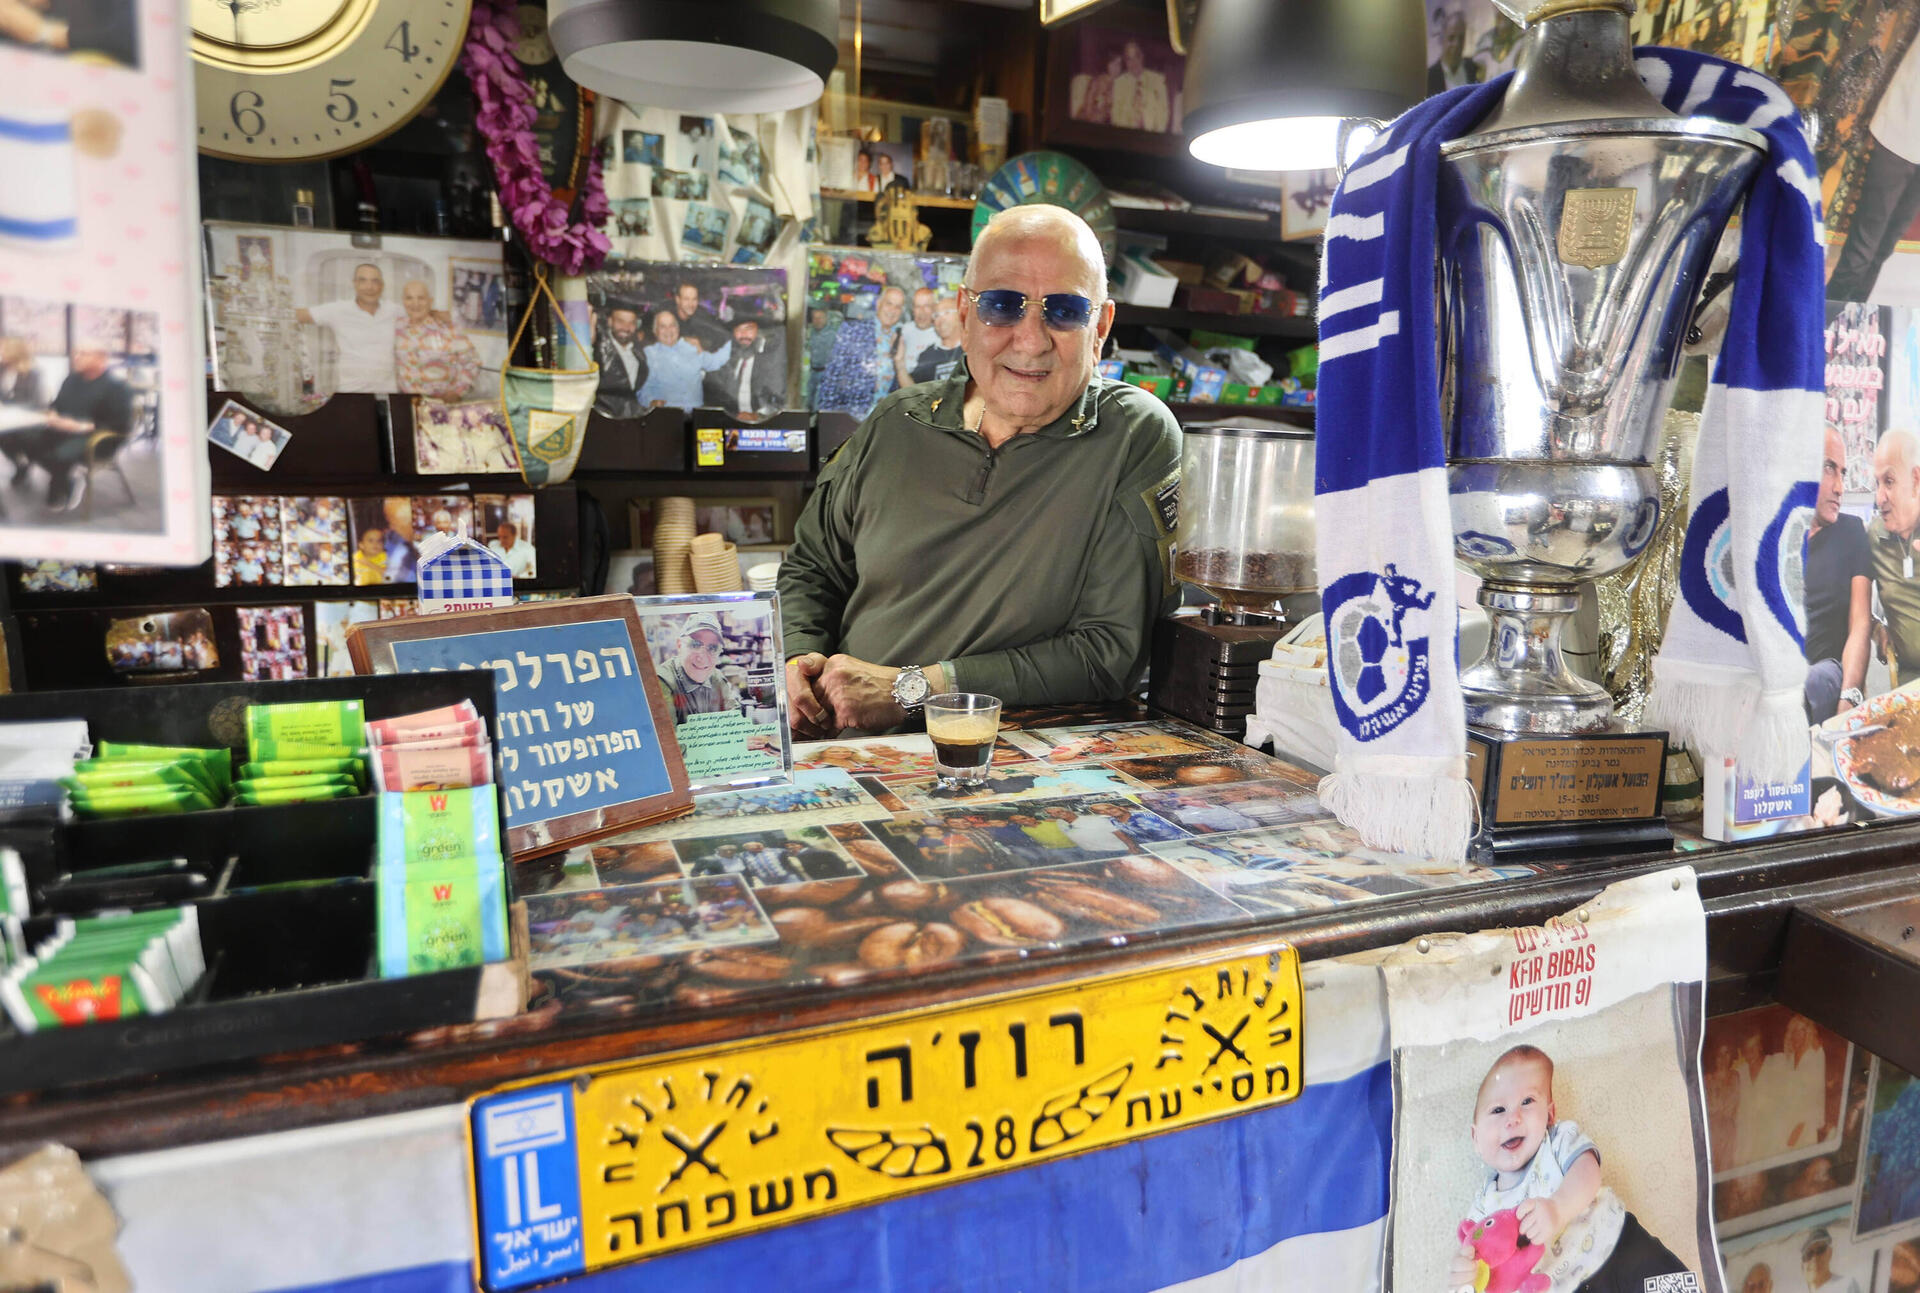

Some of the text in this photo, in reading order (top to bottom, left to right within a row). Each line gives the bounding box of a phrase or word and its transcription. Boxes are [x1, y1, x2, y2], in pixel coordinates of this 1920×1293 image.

[385, 20, 420, 63] 4
[230, 90, 266, 136] 6
[325, 78, 358, 122] 5
[412, 646, 633, 692] הפרלמ
[555, 700, 594, 729] של
[528, 728, 641, 766] הפרופסור
[1753, 799, 1793, 817] אשקלון
[1509, 943, 1596, 990] KFIR BIBAS
[965, 1114, 1017, 1168] 28
[502, 1150, 562, 1228] IL
[609, 1167, 839, 1252] משפחה
[494, 1216, 578, 1253] ישראל
